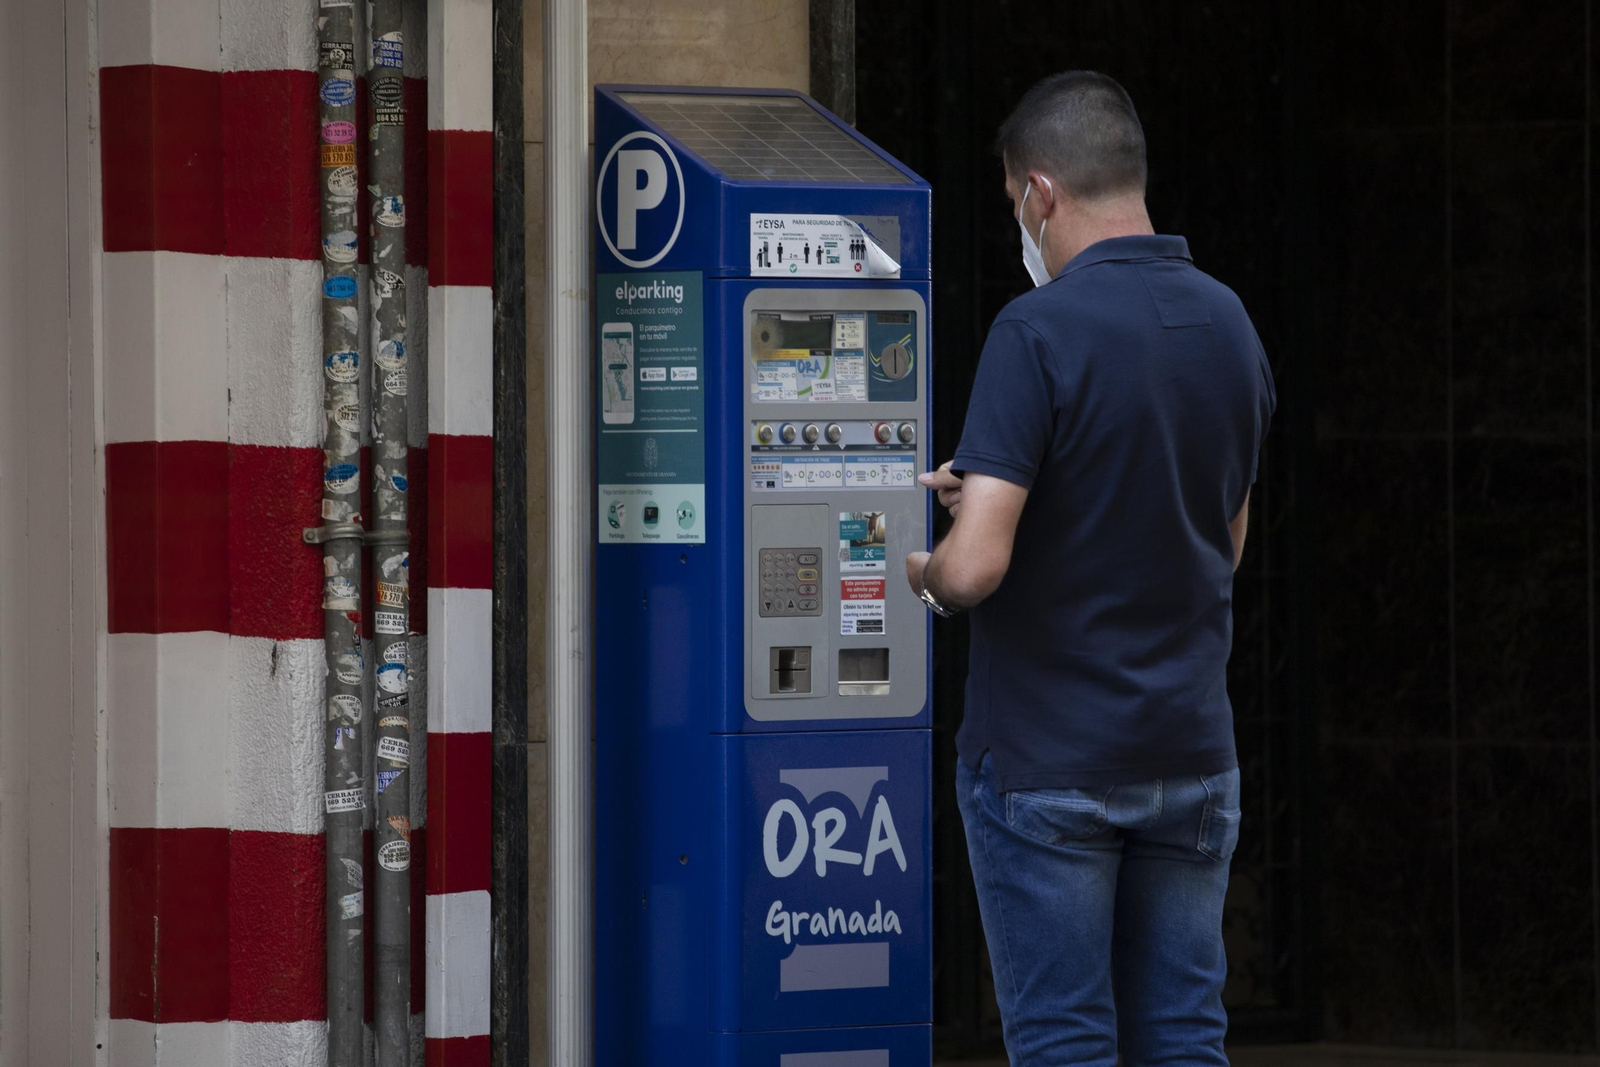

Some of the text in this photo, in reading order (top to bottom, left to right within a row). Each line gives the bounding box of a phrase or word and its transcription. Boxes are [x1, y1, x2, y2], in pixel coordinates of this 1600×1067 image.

[618, 150, 668, 250] P
[764, 220, 785, 229] EYSA
[616, 280, 683, 305] elparking
[658, 306, 683, 315] contigo
[797, 360, 822, 373] ORA
[864, 549, 874, 558] 2€
[763, 794, 907, 878] ORA
[765, 900, 902, 944] Granada
